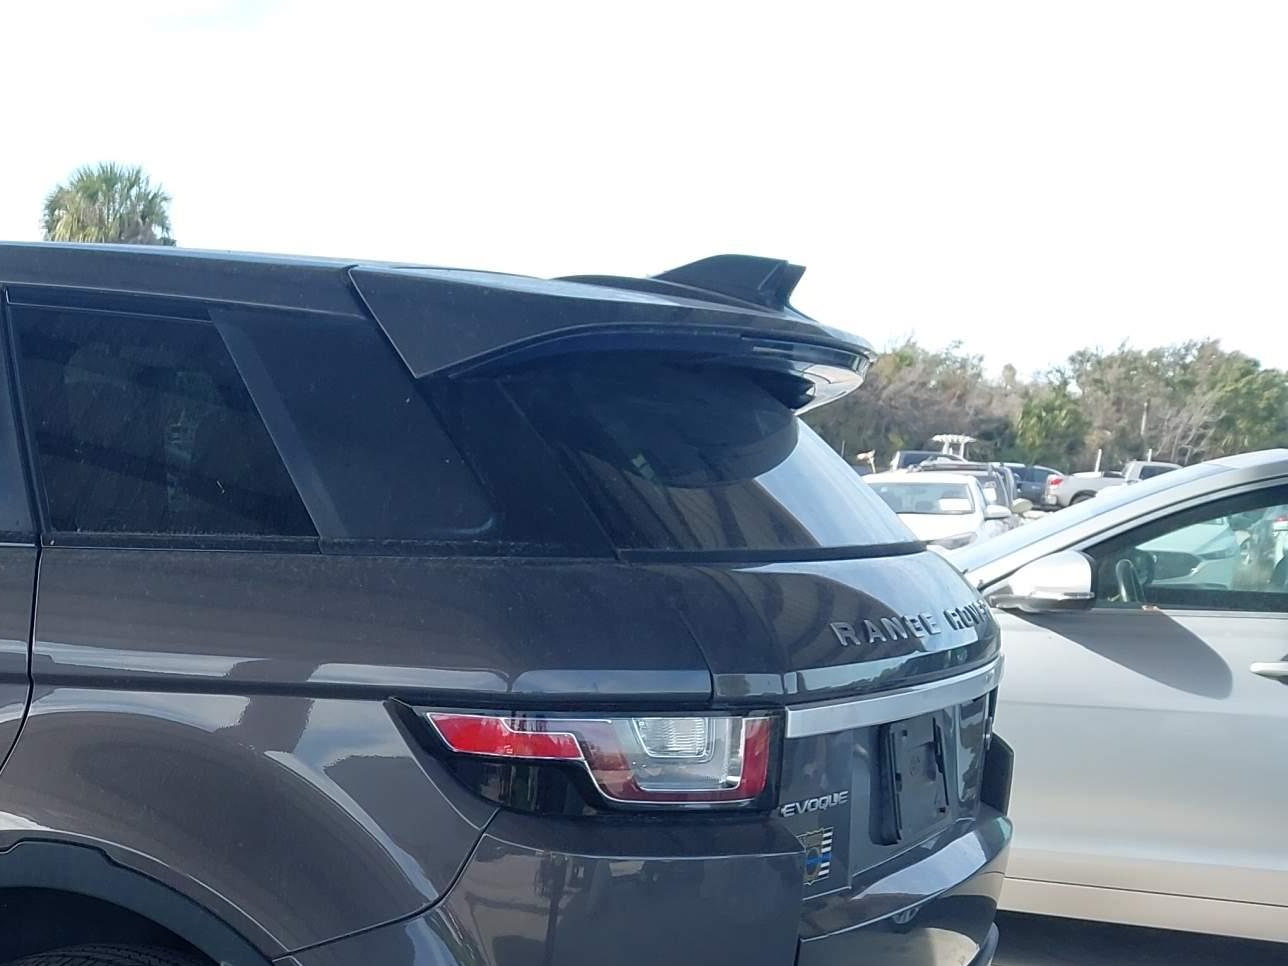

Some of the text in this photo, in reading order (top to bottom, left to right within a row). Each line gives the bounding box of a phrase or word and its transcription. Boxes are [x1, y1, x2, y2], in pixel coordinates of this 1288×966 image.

[830, 600, 987, 646] RANGE ROVE
[781, 790, 849, 817] EVOQUE
